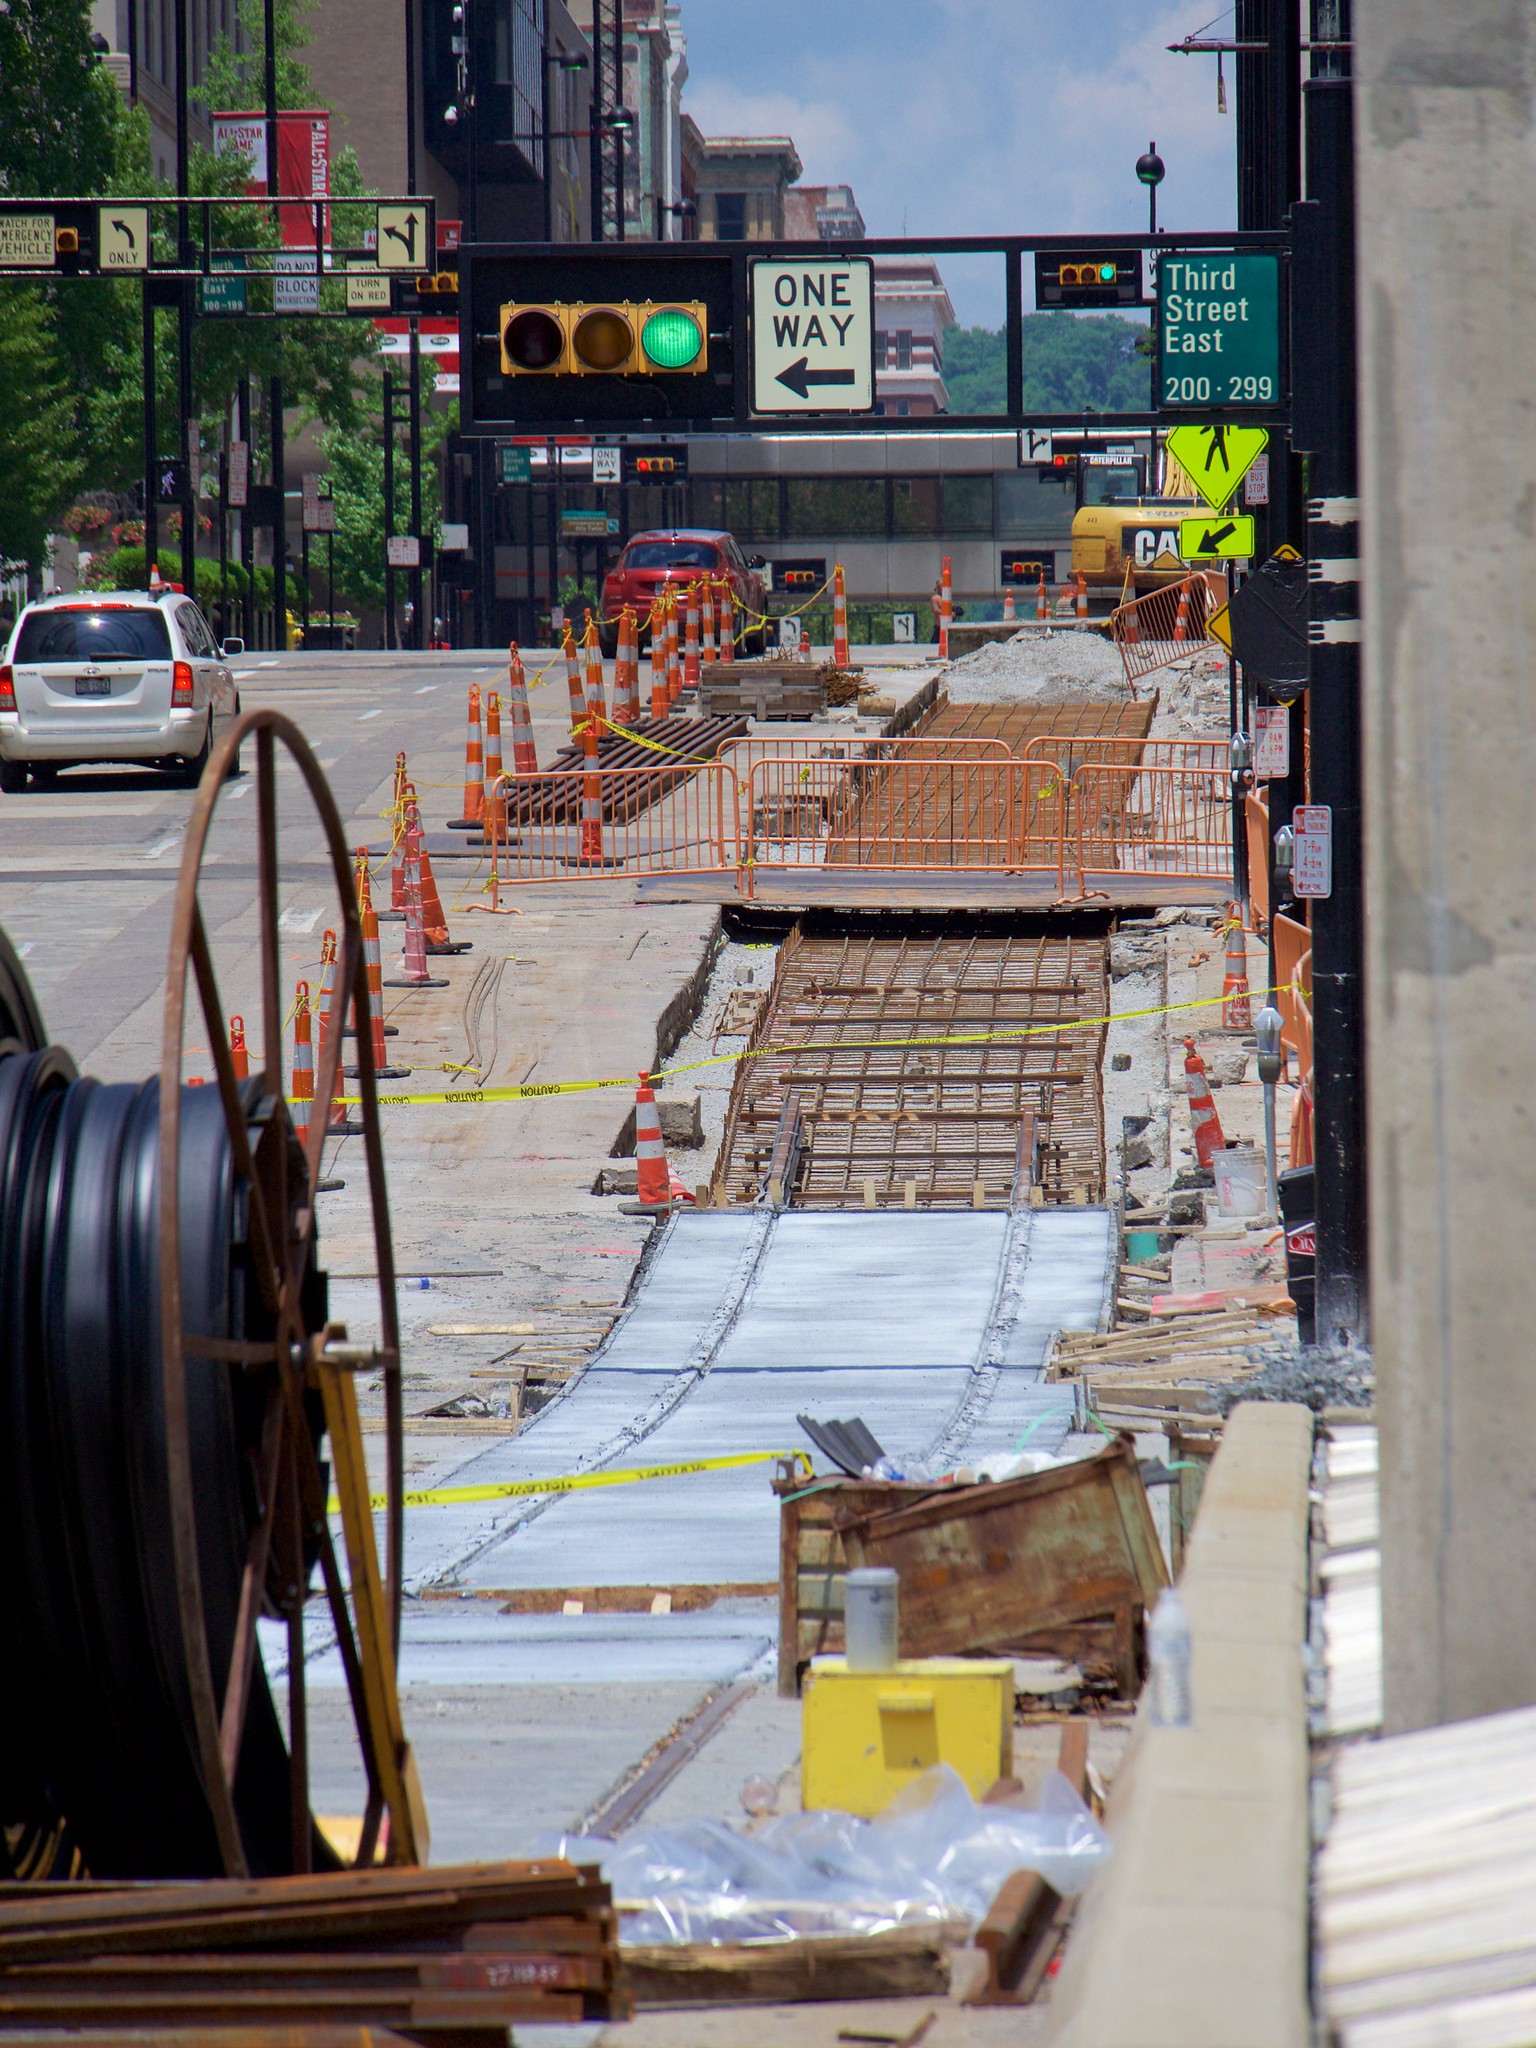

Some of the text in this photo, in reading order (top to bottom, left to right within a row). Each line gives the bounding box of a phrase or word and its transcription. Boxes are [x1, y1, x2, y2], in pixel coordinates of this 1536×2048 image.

[32, 218, 50, 228] FOR
[0, 230, 52, 241] MERGENCY
[109, 252, 138, 264] ONLY
[1166, 263, 1235, 291] Third
[277, 280, 316, 292] BLOCK
[355, 279, 380, 288] TURN
[774, 273, 851, 307] ONE
[351, 292, 386, 300] ON RED
[1166, 295, 1249, 322] Street
[773, 314, 855, 347] WAY
[1166, 325, 1223, 353] East
[597, 450, 615, 458] ONE
[597, 460, 616, 468] WAY
[1090, 456, 1132, 465] CATERPILLAR
[1250, 473, 1264, 481] BUS
[1249, 484, 1265, 493] STOP
[1135, 529, 1190, 568] CA
[520, 1084, 560, 1097] CAUTION
[378, 1096, 411, 1104] CAUTIO
[444, 1091, 483, 1103] CAUTION
